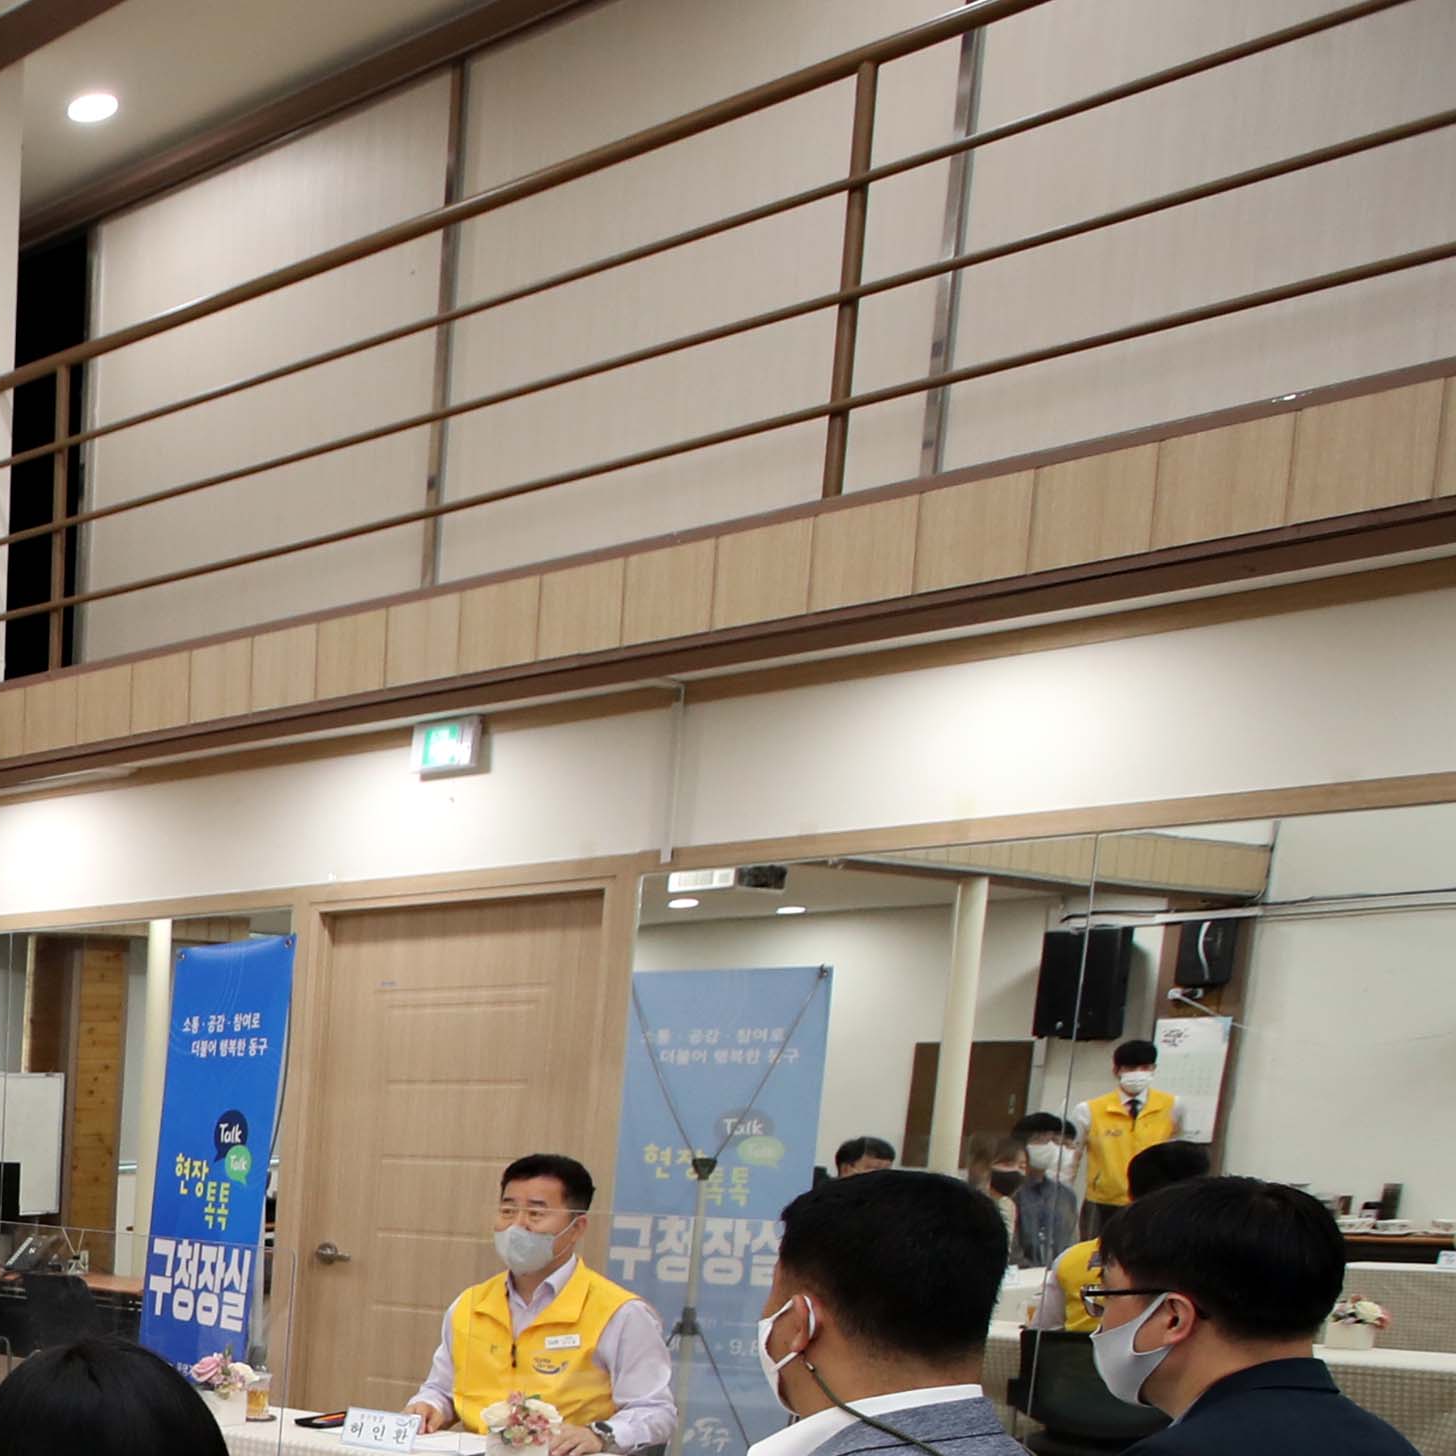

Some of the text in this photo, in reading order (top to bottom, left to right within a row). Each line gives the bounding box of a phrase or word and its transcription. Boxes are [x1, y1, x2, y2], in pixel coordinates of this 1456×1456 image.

[191, 1037, 268, 1057] 더불어 행복한 동구
[219, 1122, 243, 1143] Talk
[175, 1152, 210, 1197] 현장
[230, 1154, 248, 1172] Talk
[204, 1181, 230, 1231] 톡톡
[149, 1237, 252, 1333] 구청장실
